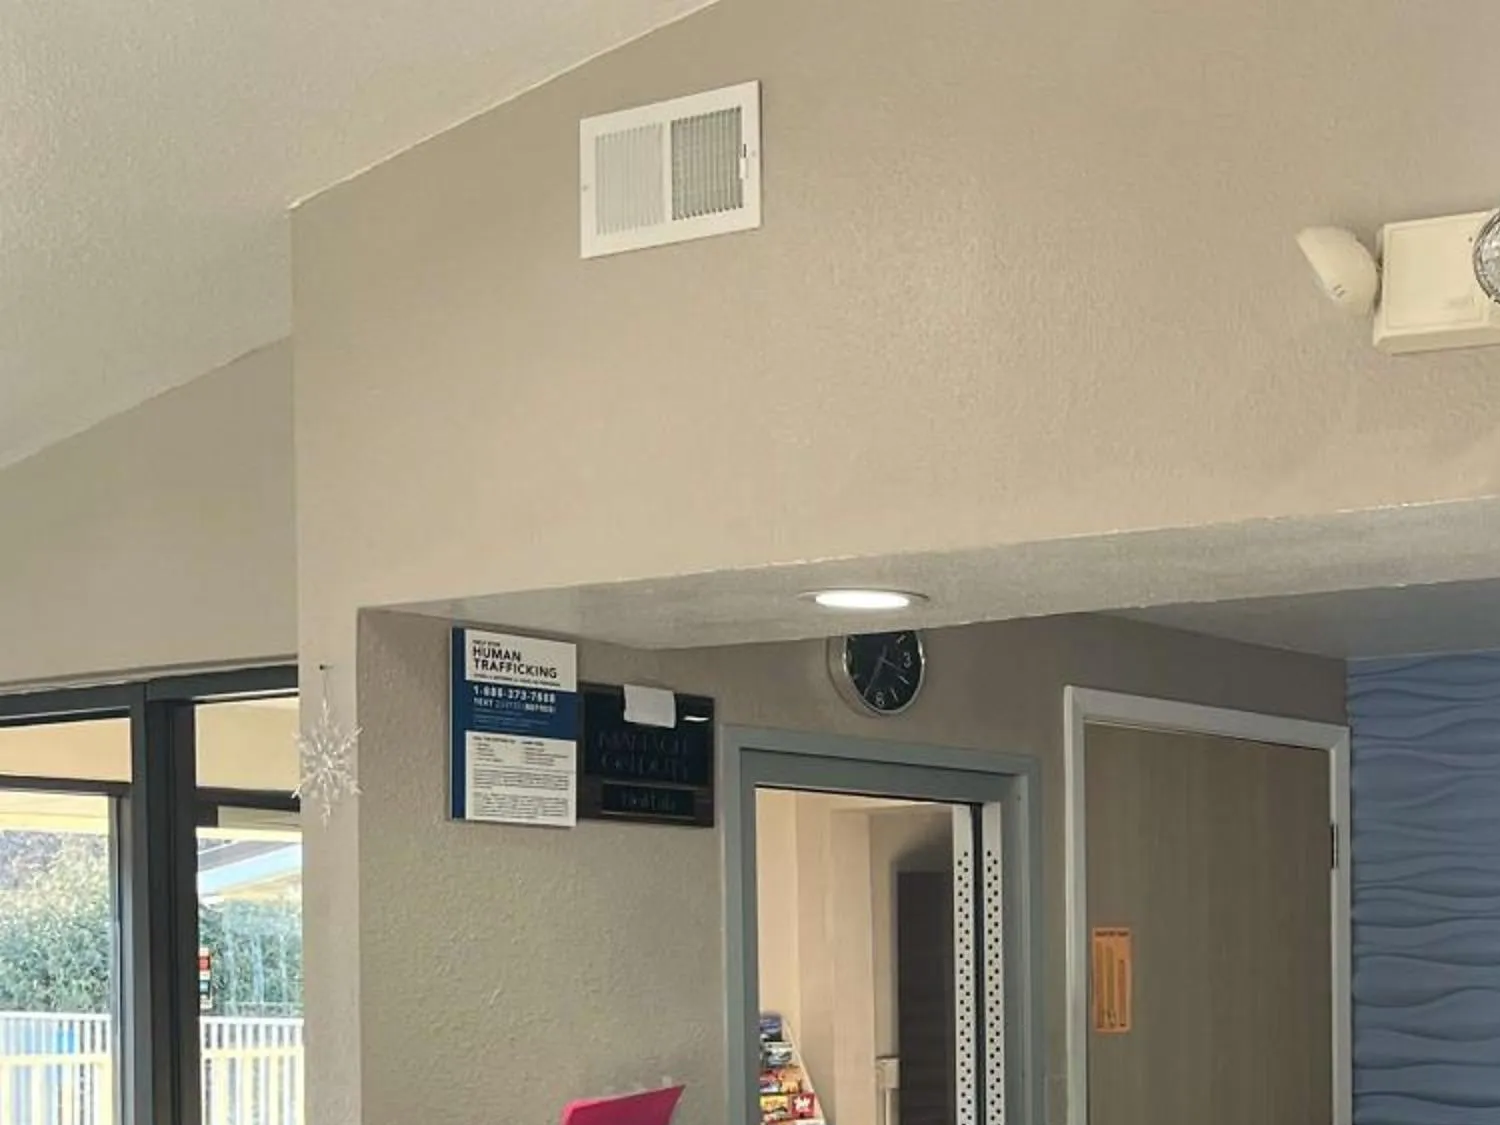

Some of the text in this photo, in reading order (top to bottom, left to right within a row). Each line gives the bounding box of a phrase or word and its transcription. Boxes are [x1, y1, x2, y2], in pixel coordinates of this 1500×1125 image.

[472, 646, 521, 662] HUMAN
[903, 651, 912, 669] 3
[474, 658, 557, 679] TRAFFICKING
